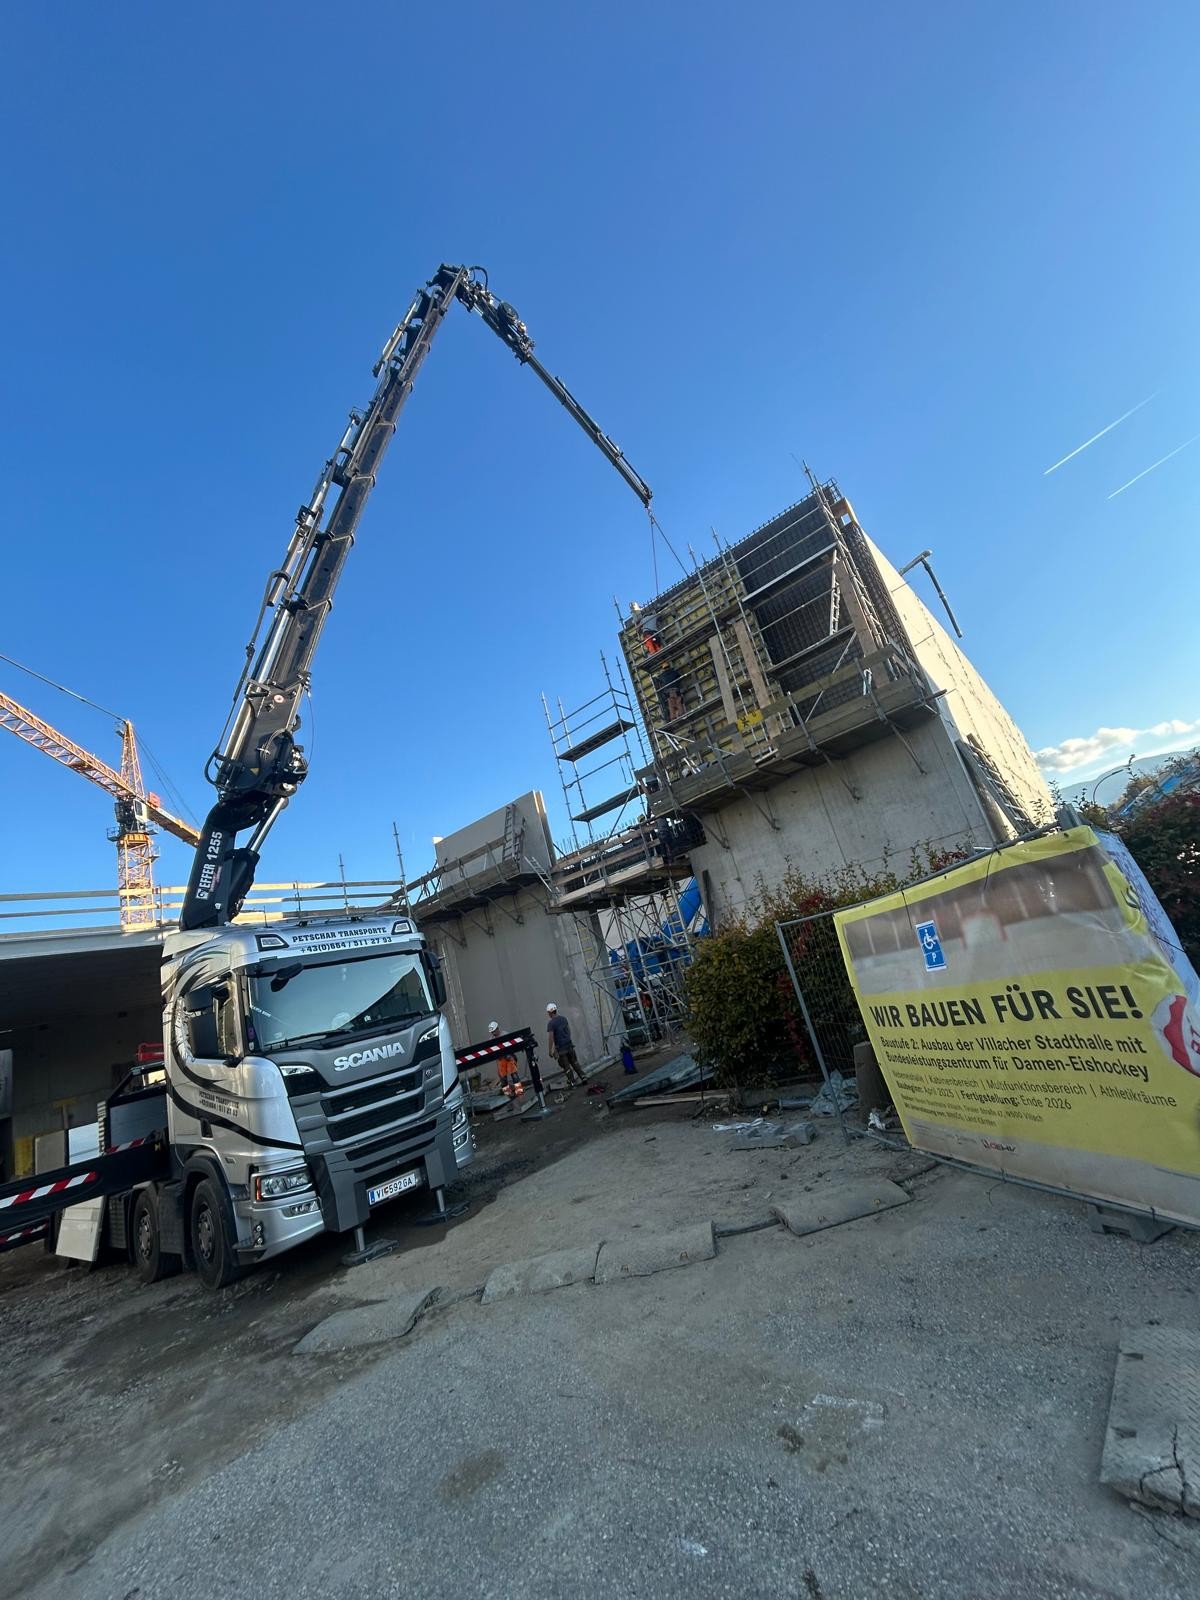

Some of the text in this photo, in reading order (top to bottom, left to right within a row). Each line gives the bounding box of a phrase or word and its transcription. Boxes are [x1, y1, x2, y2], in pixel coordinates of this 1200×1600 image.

[206, 831, 223, 860] 1255
[199, 863, 216, 889] EFFER
[292, 926, 387, 943] PETSCHAR TRANSPORTE
[931, 952, 937, 963] P
[869, 983, 1144, 1028] WIR BAUEN FÜR SIE!
[333, 1042, 405, 1072] SCANIA
[880, 1034, 1148, 1054] Baustufe 2: Ausbau der Villacher Stadthalle mit
[885, 1051, 1149, 1082] Bundesleistungszentrum für Damen-Eishockey
[937, 1087, 955, 1098] 2025
[960, 1089, 1020, 1107] Fertigstellung:
[1020, 1094, 1043, 1108] Ende
[1044, 1097, 1072, 1110] 2026
[986, 1080, 1088, 1096] Multifunktionsbereich
[1099, 1084, 1178, 1107] Athletikräume
